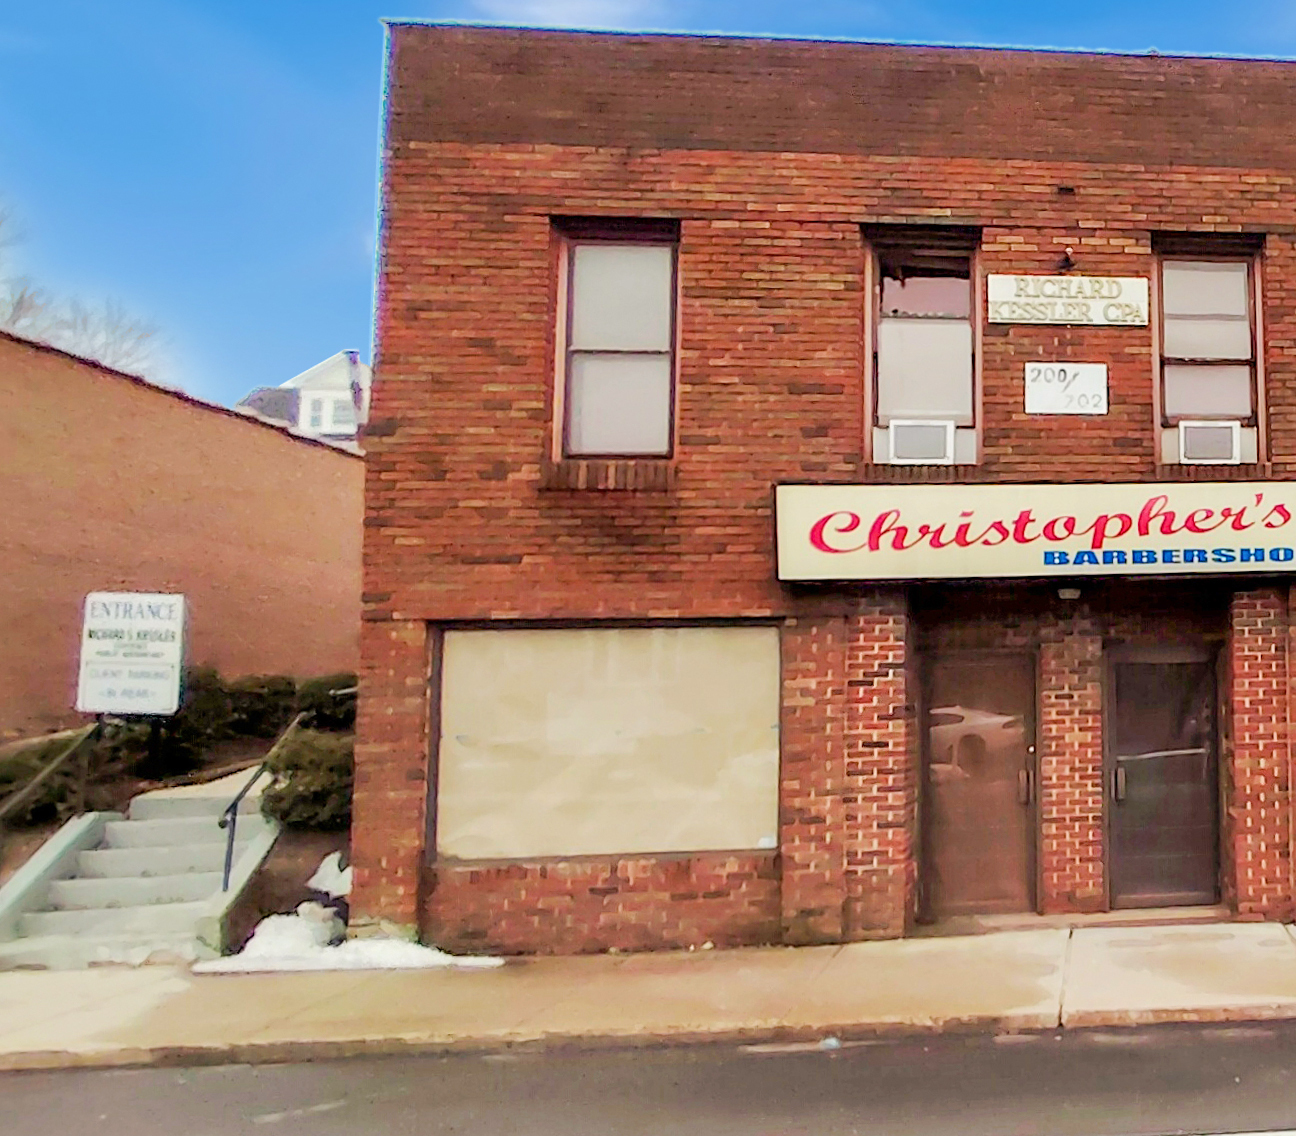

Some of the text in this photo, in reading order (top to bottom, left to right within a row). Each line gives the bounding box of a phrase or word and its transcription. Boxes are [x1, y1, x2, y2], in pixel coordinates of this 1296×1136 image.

[1014, 277, 1123, 299] RICHARD
[988, 301, 1146, 322] KESSLER CPA
[808, 493, 1291, 555] Christopher's
[90, 602, 178, 620] ENTRANCE
